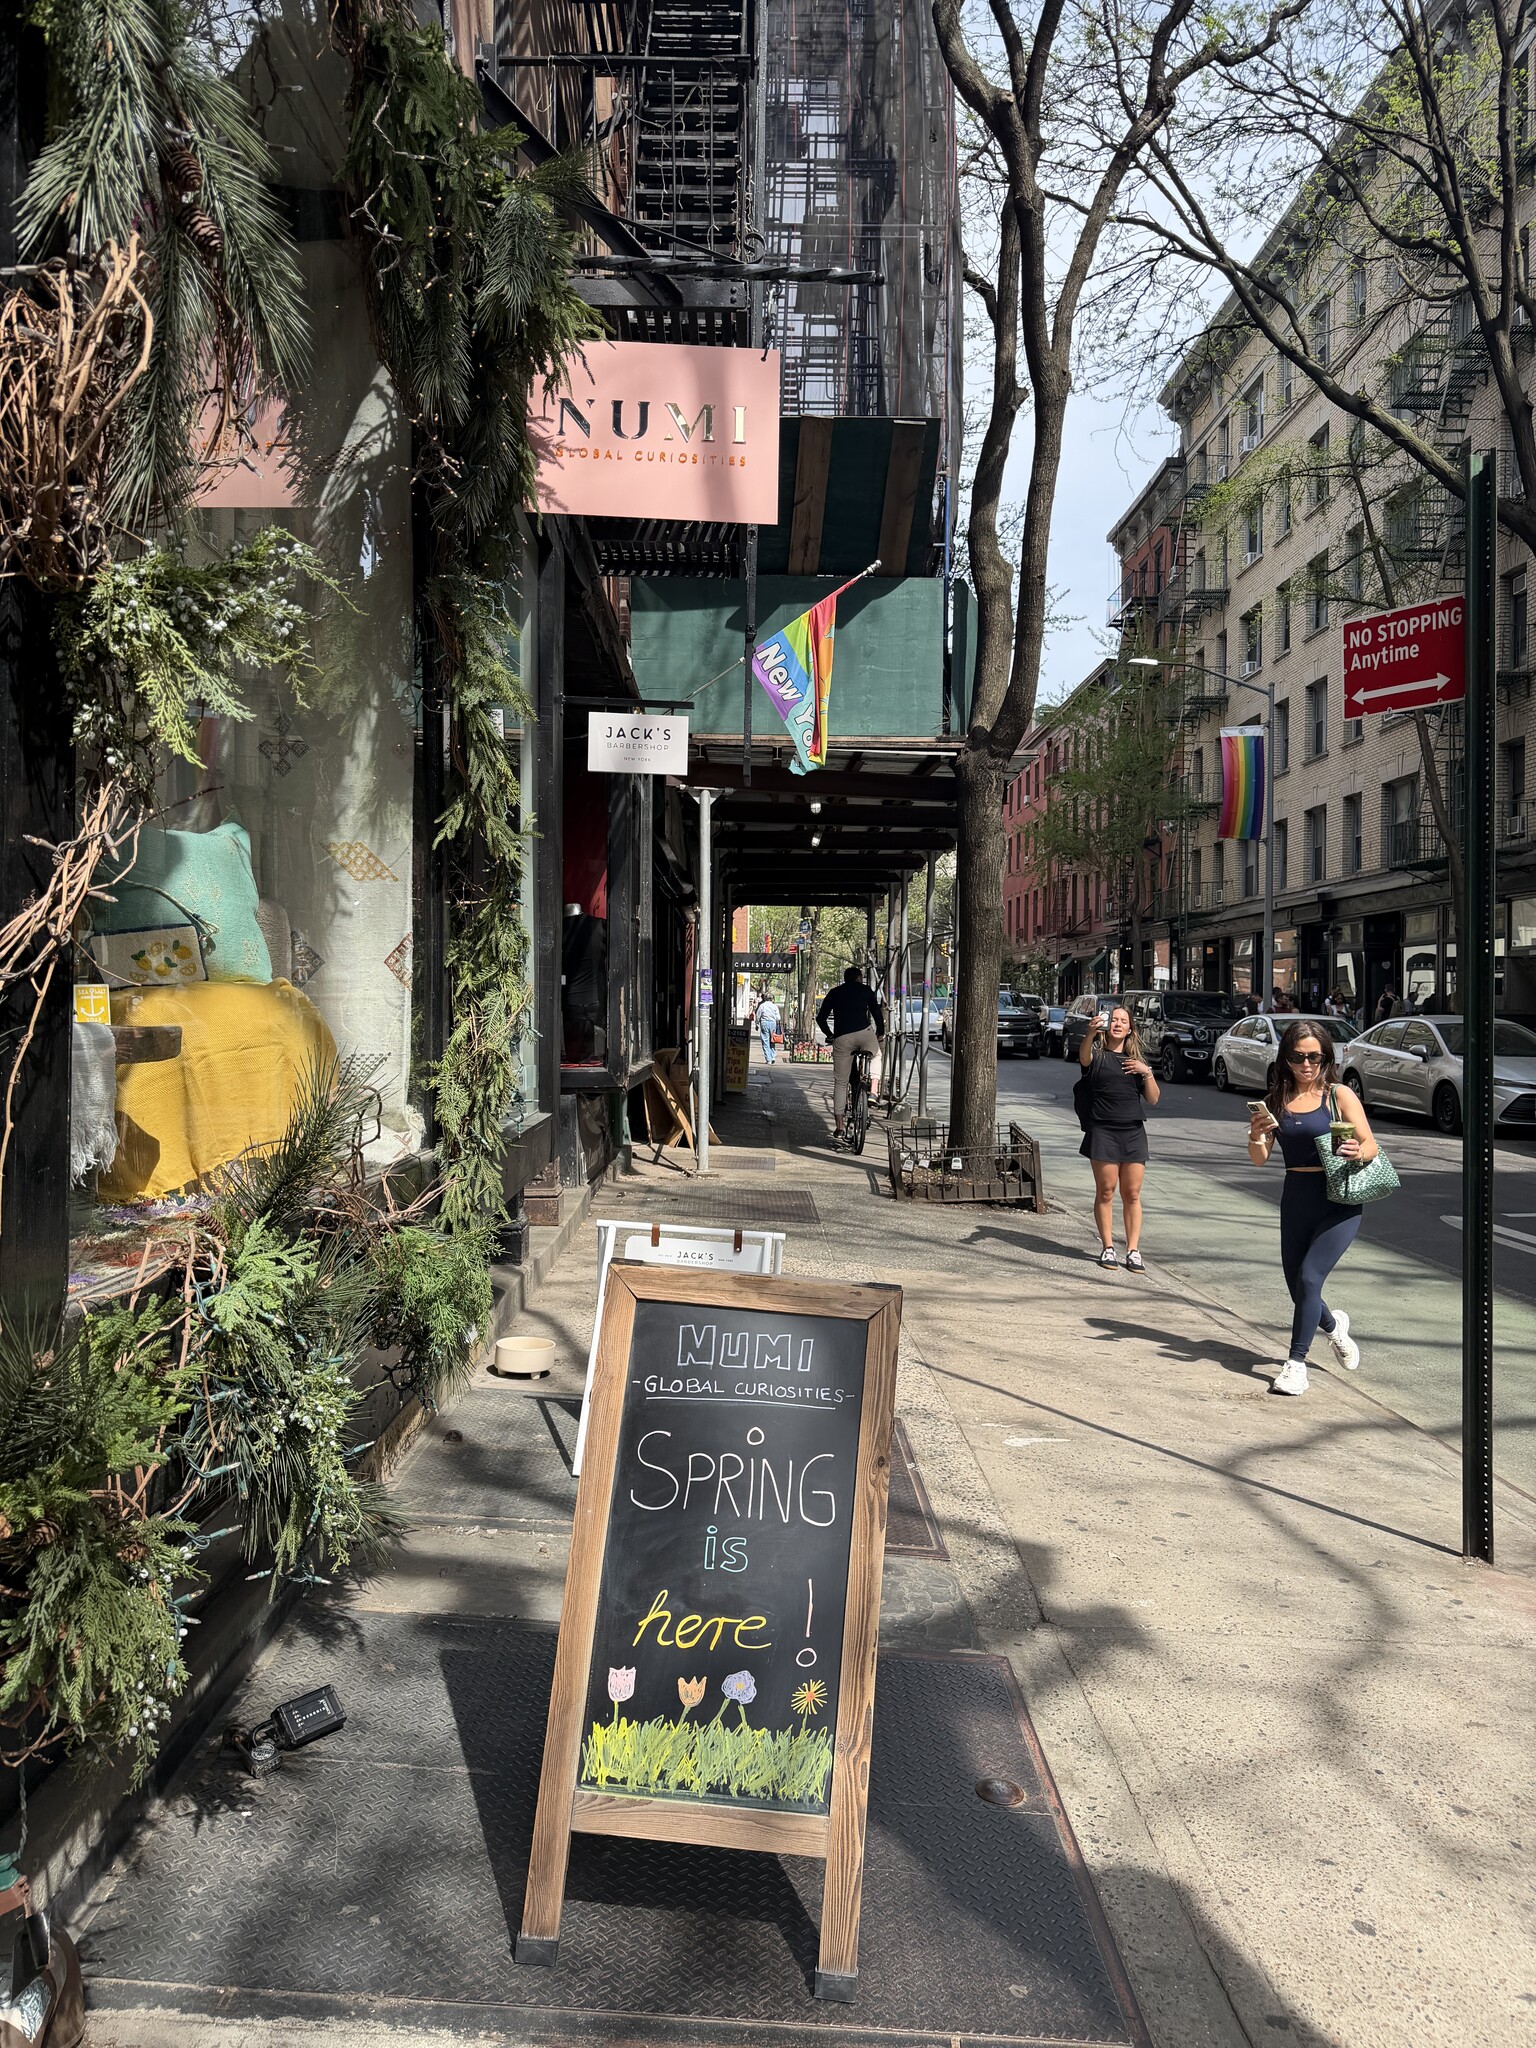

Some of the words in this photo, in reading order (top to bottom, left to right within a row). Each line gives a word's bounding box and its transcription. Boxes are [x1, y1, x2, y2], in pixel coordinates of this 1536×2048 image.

[556, 397, 748, 445] NUMI
[555, 447, 624, 462] GLOBAL
[634, 449, 748, 468] CURIOSITIES
[1349, 627, 1372, 649] NO
[1377, 606, 1463, 642] STOPPING
[1350, 643, 1420, 671] Anytime
[755, 641, 803, 701] New
[793, 701, 816, 752] Yo
[605, 726, 671, 741] JACK'S
[606, 741, 669, 751] BARBERSHOP
[677, 1251, 714, 1261] JACK'S
[677, 1324, 815, 1372] NUMI
[630, 1426, 836, 1527] SPRING
[704, 1525, 749, 1573] is
[631, 1589, 772, 1651] here
